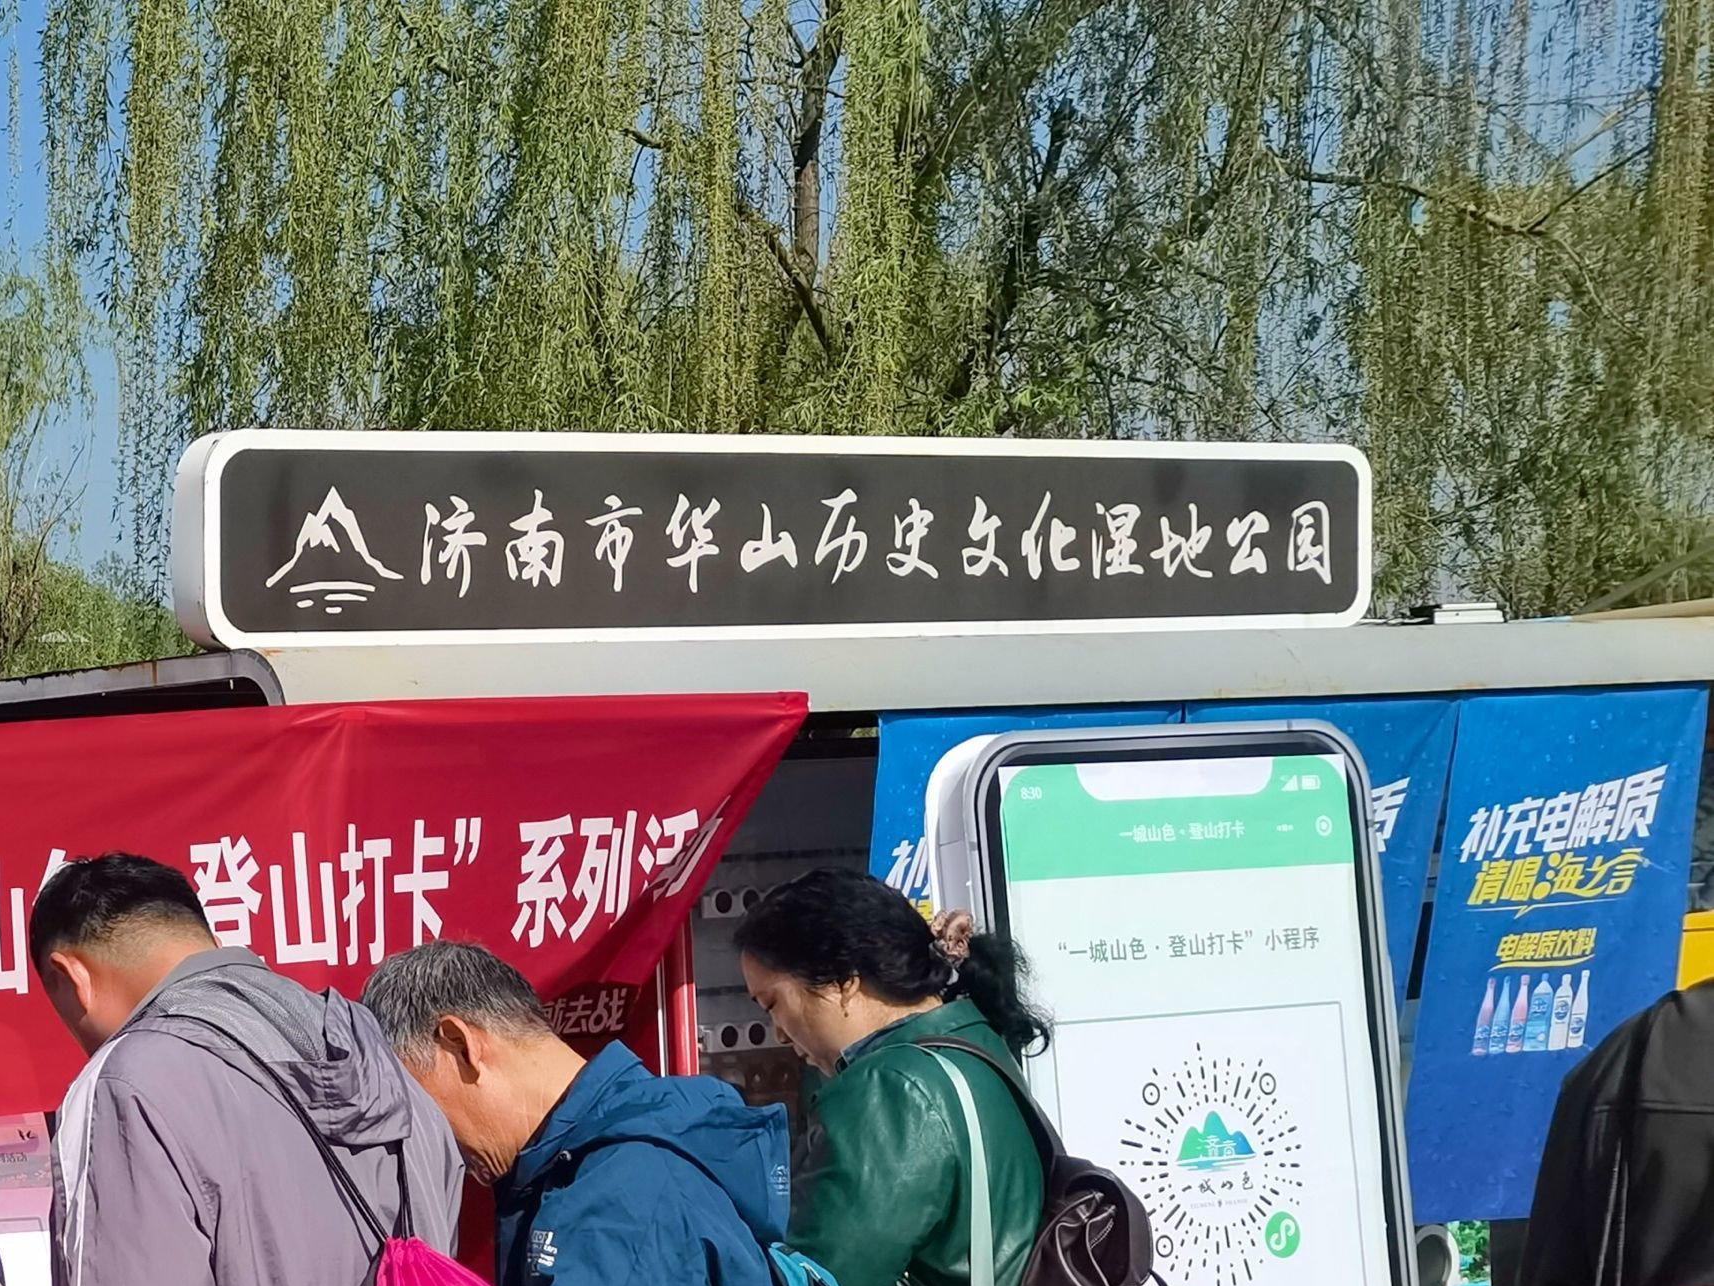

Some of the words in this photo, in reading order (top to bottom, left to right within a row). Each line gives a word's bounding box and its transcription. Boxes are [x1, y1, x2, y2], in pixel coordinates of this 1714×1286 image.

[420, 488, 1332, 598] 济南市华山历史文化湿地公园
[1459, 764, 1668, 863] 补充电解质
[1496, 928, 1597, 961] 电解质饮料
